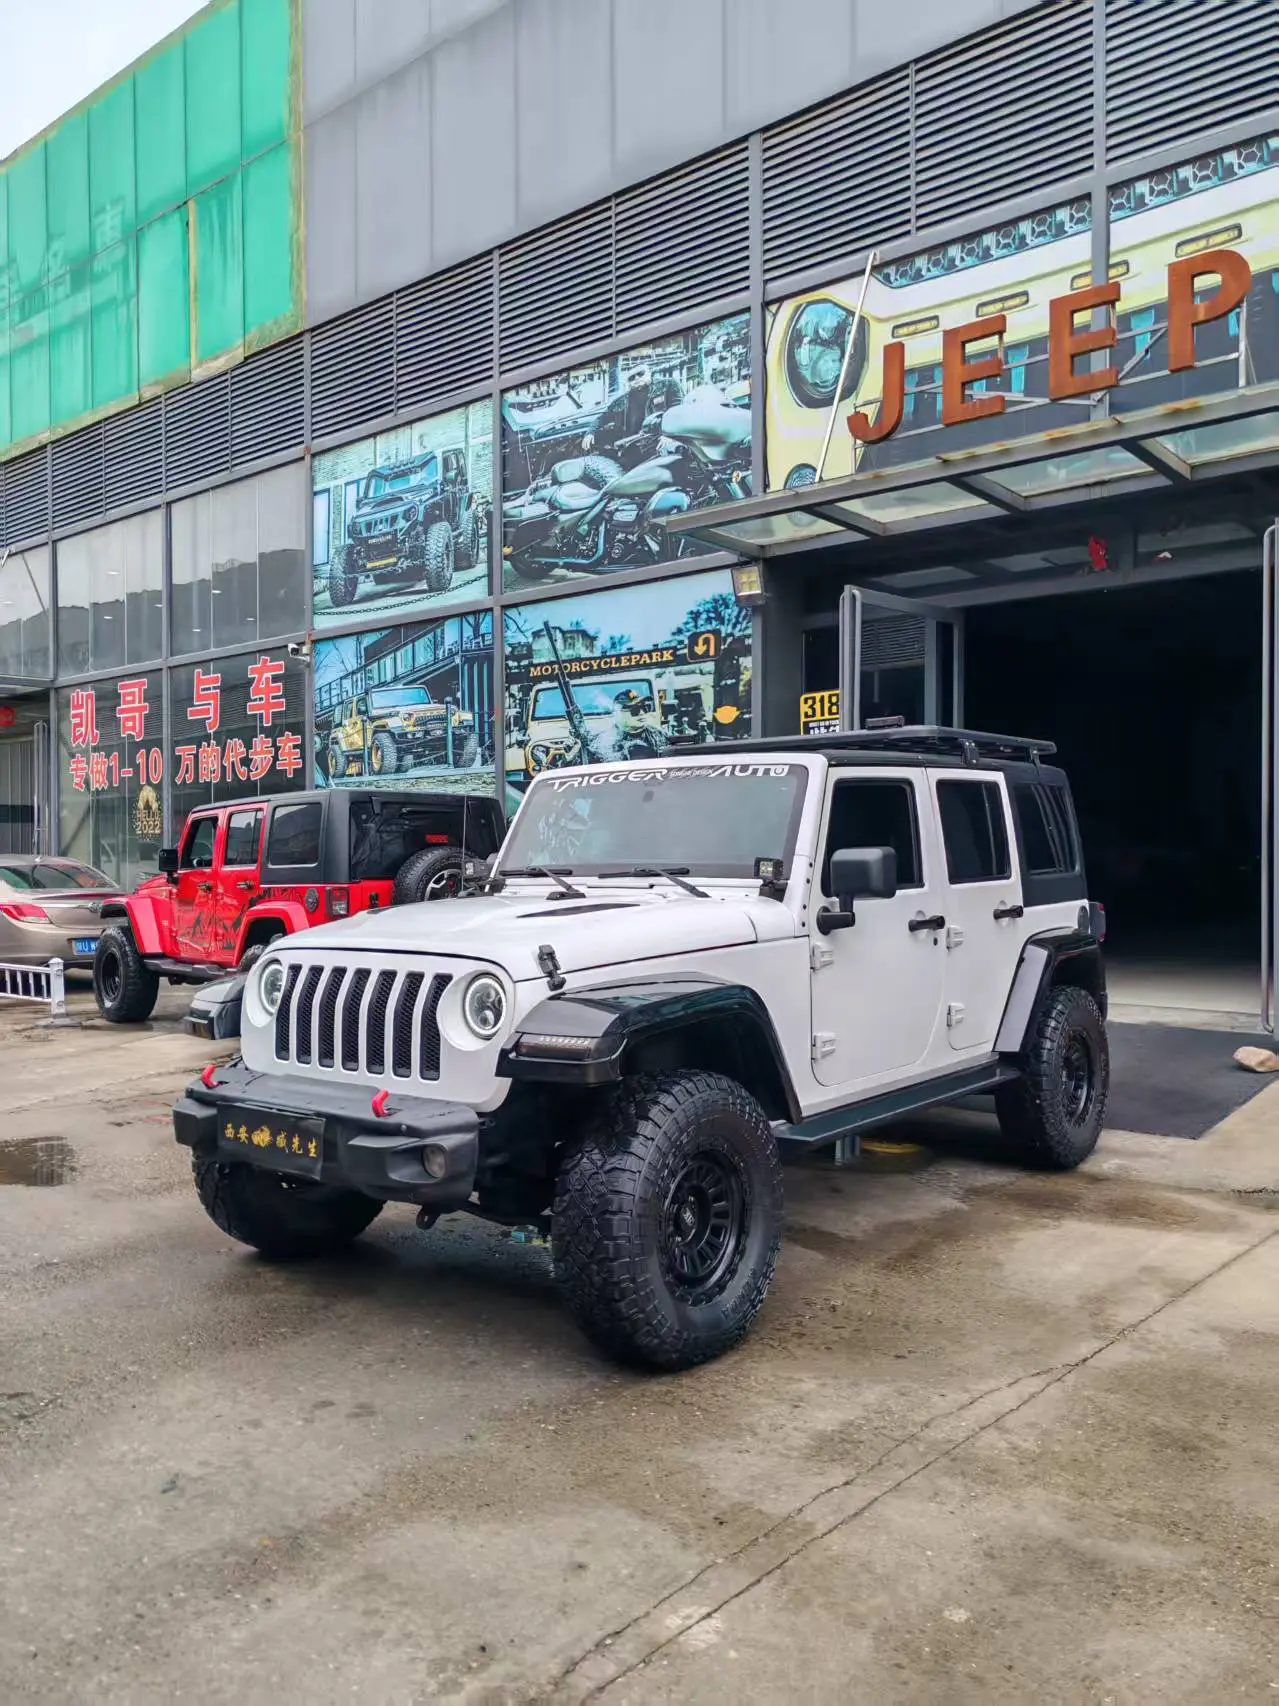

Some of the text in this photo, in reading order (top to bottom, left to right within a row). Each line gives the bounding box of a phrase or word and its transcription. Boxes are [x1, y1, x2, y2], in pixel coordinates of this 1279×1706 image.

[846, 249, 1253, 444] JEEP
[803, 693, 840, 719] 318
[547, 768, 668, 793] TRIGGER
[707, 764, 790, 778] AUTO
[135, 820, 161, 834] 2022
[136, 809, 160, 821] HELLO
